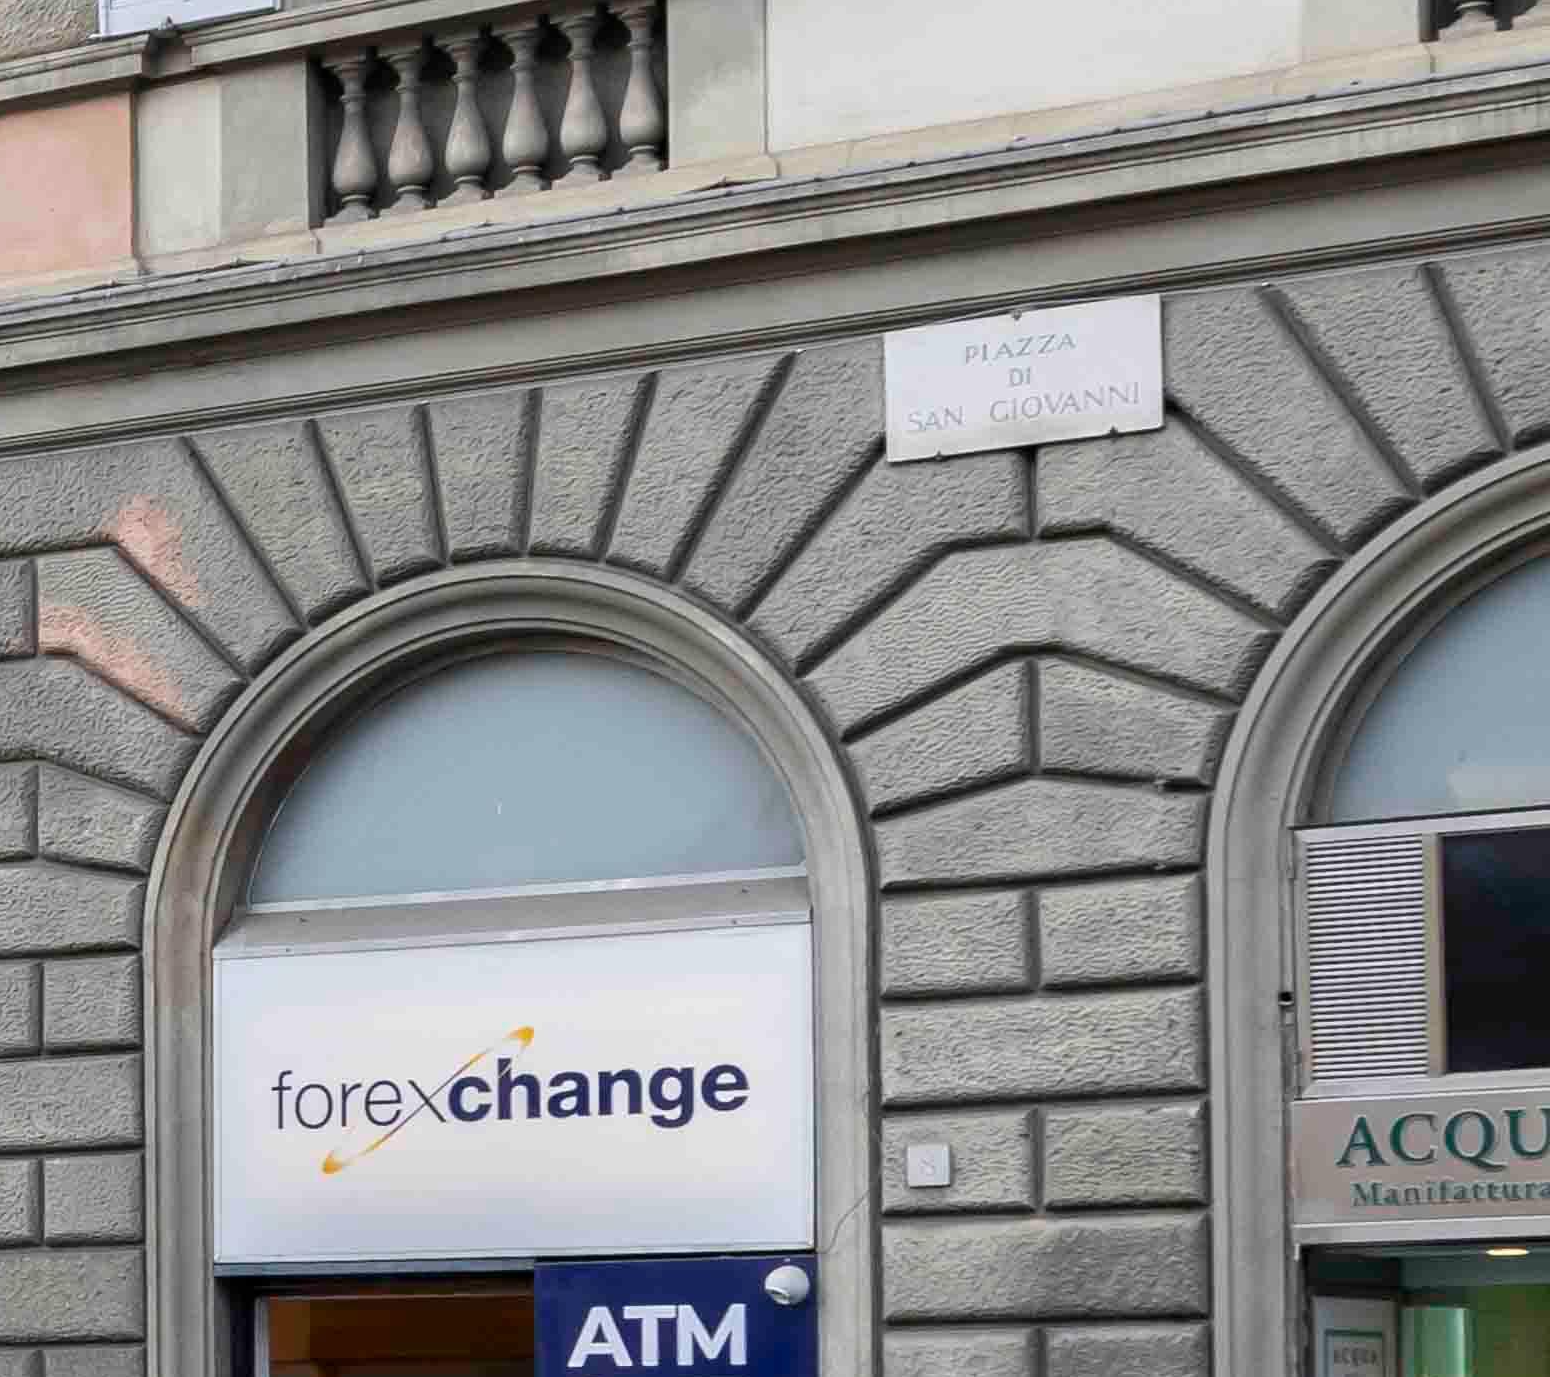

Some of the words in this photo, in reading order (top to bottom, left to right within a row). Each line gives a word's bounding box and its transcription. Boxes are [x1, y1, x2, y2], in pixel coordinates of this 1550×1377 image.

[965, 333, 1077, 364] PIAZZA
[1008, 368, 1032, 388] DI
[908, 405, 965, 431] SAN
[989, 381, 1140, 423] GIOVANNI
[271, 1057, 750, 1129] forexchange
[566, 1303, 748, 1368] ATM
